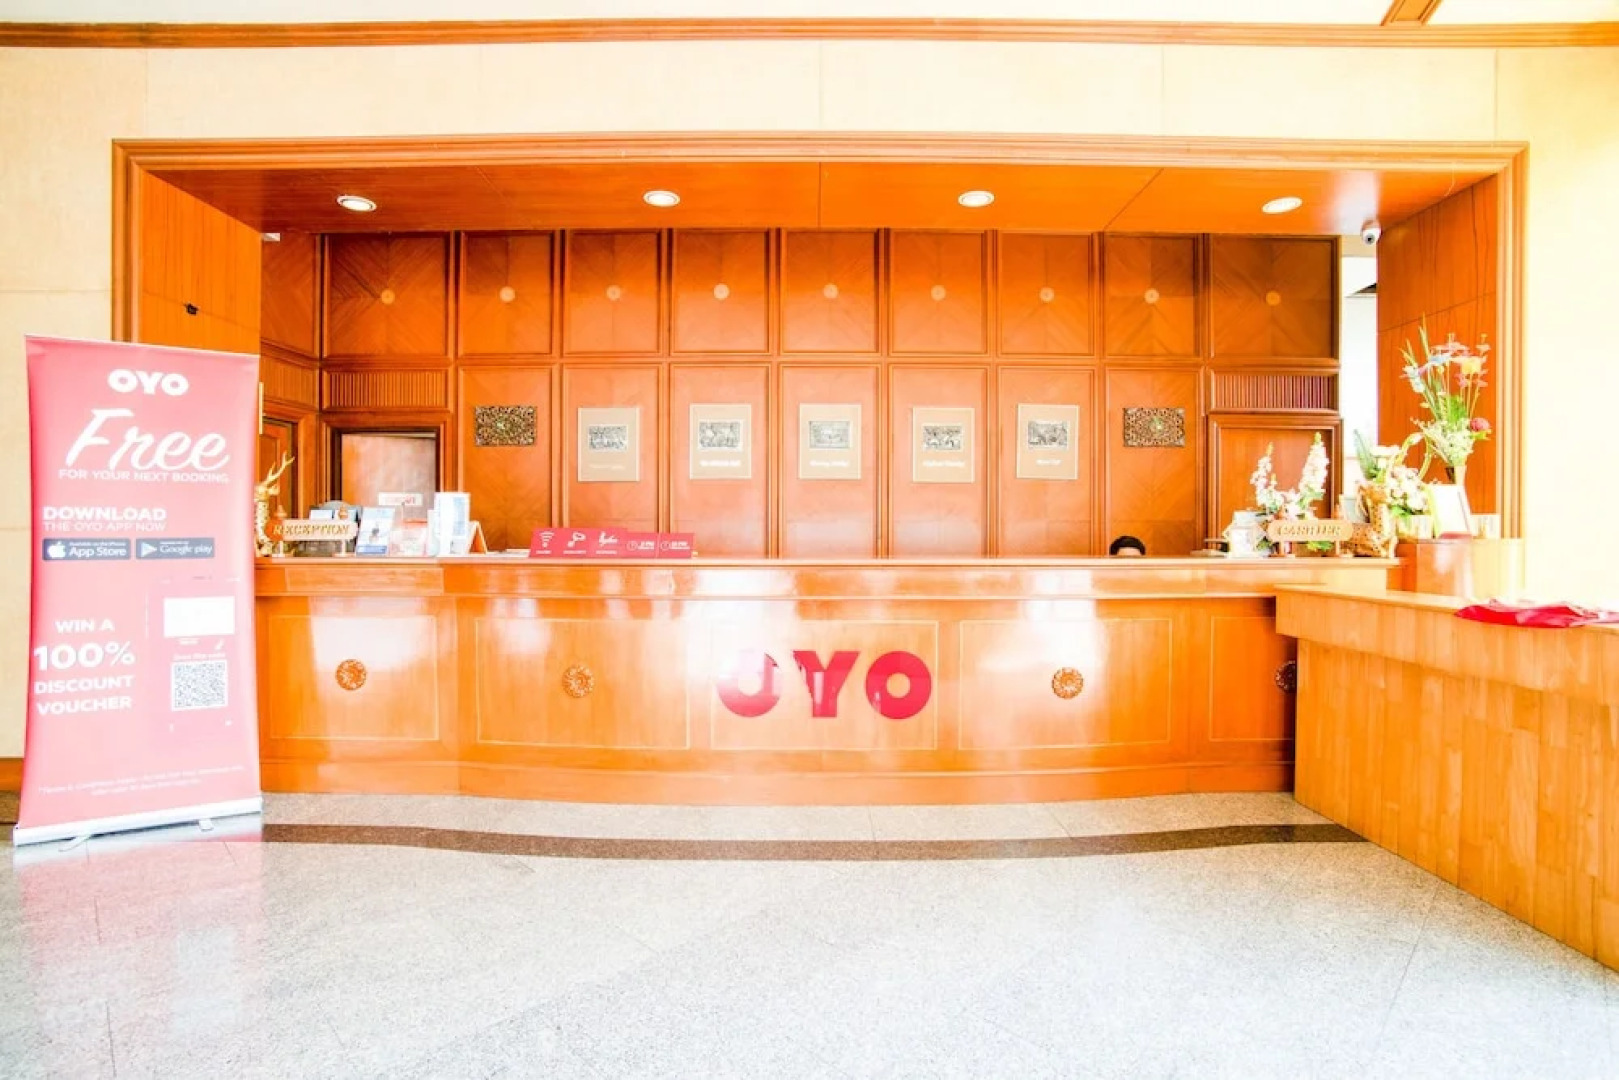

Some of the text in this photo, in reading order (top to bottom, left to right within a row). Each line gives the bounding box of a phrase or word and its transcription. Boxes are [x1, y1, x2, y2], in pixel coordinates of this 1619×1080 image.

[107, 368, 190, 396] OYO
[65, 407, 231, 472] Free
[58, 468, 231, 485] FOR YOUR NEXT BOOKING
[42, 505, 168, 521] DOWNLOAD
[43, 521, 167, 532] THE OYO APP NOW
[272, 522, 351, 536] RECEPTION
[69, 545, 128, 557] App Store
[159, 543, 213, 557] Google play
[55, 618, 116, 634] WIN A
[33, 641, 136, 672] 100%
[34, 674, 135, 694] DISCOUNT
[36, 696, 133, 716] VOUCHER
